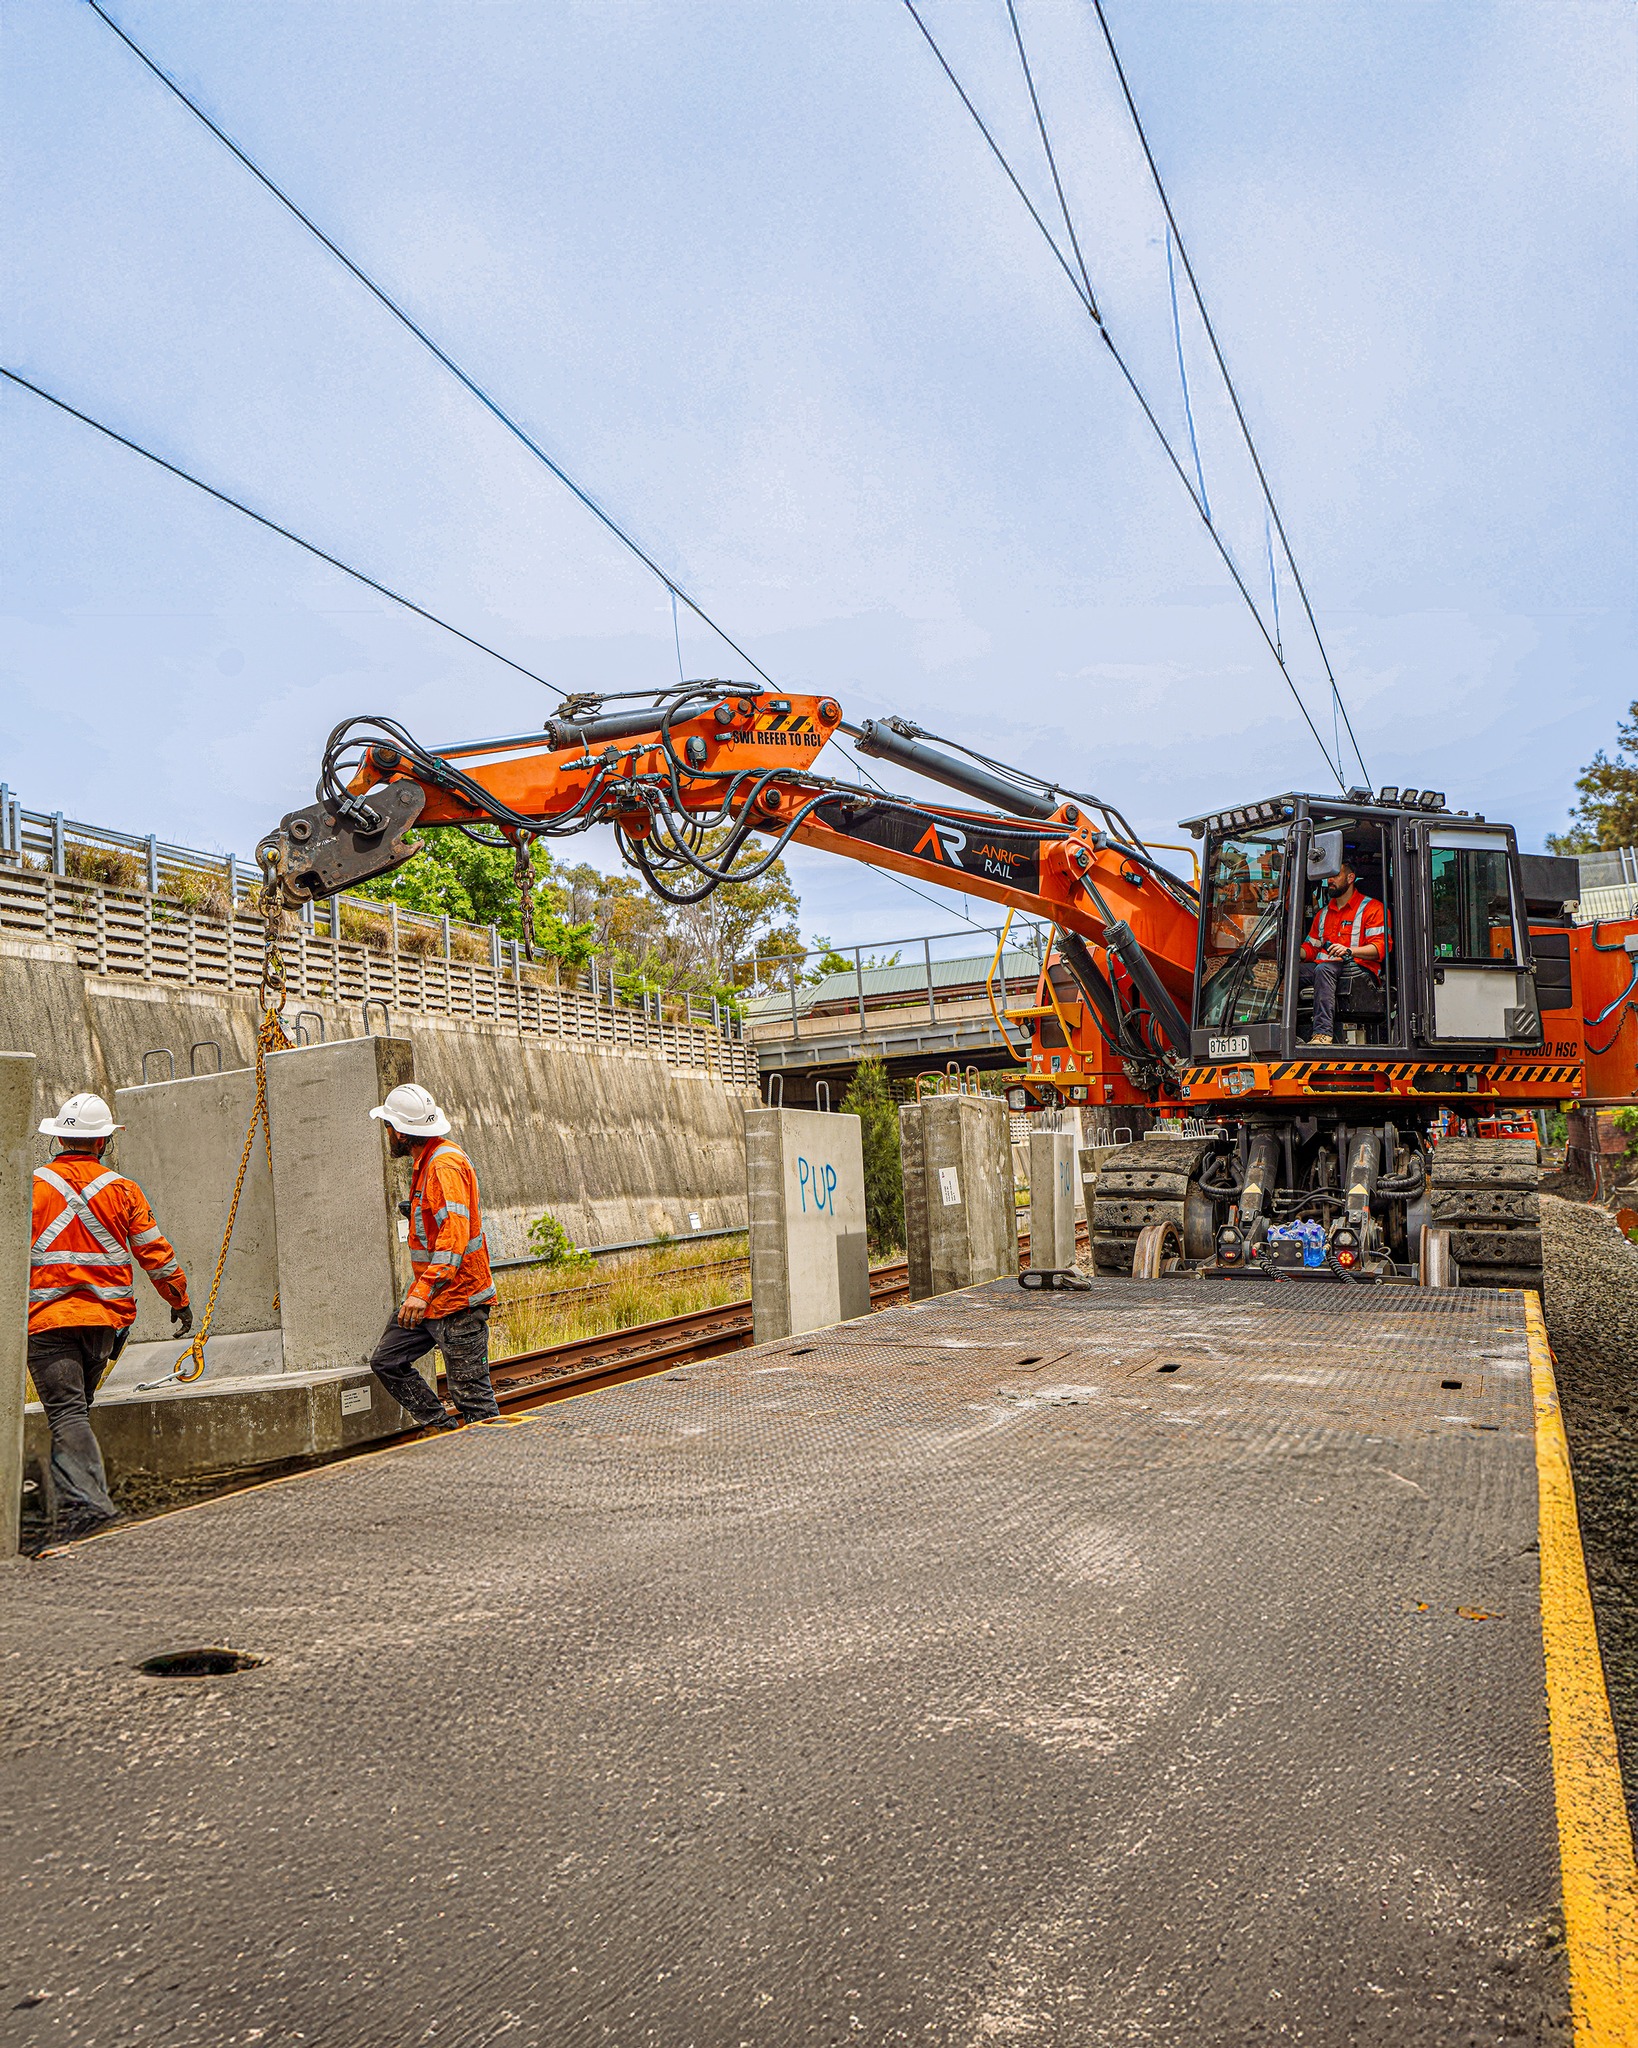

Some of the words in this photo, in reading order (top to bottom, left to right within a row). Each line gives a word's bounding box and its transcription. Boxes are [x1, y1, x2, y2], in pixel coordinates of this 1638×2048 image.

[733, 731, 755, 744] SWL
[758, 732, 787, 745] REFER
[789, 733, 801, 746] TO
[804, 734, 821, 747] RCI
[973, 844, 1029, 866] ANRIC
[985, 859, 1013, 879] RAIL
[1555, 1042, 1578, 1057] HSC
[1183, 1086, 1190, 1096] 13
[798, 1156, 837, 1216] PUP
